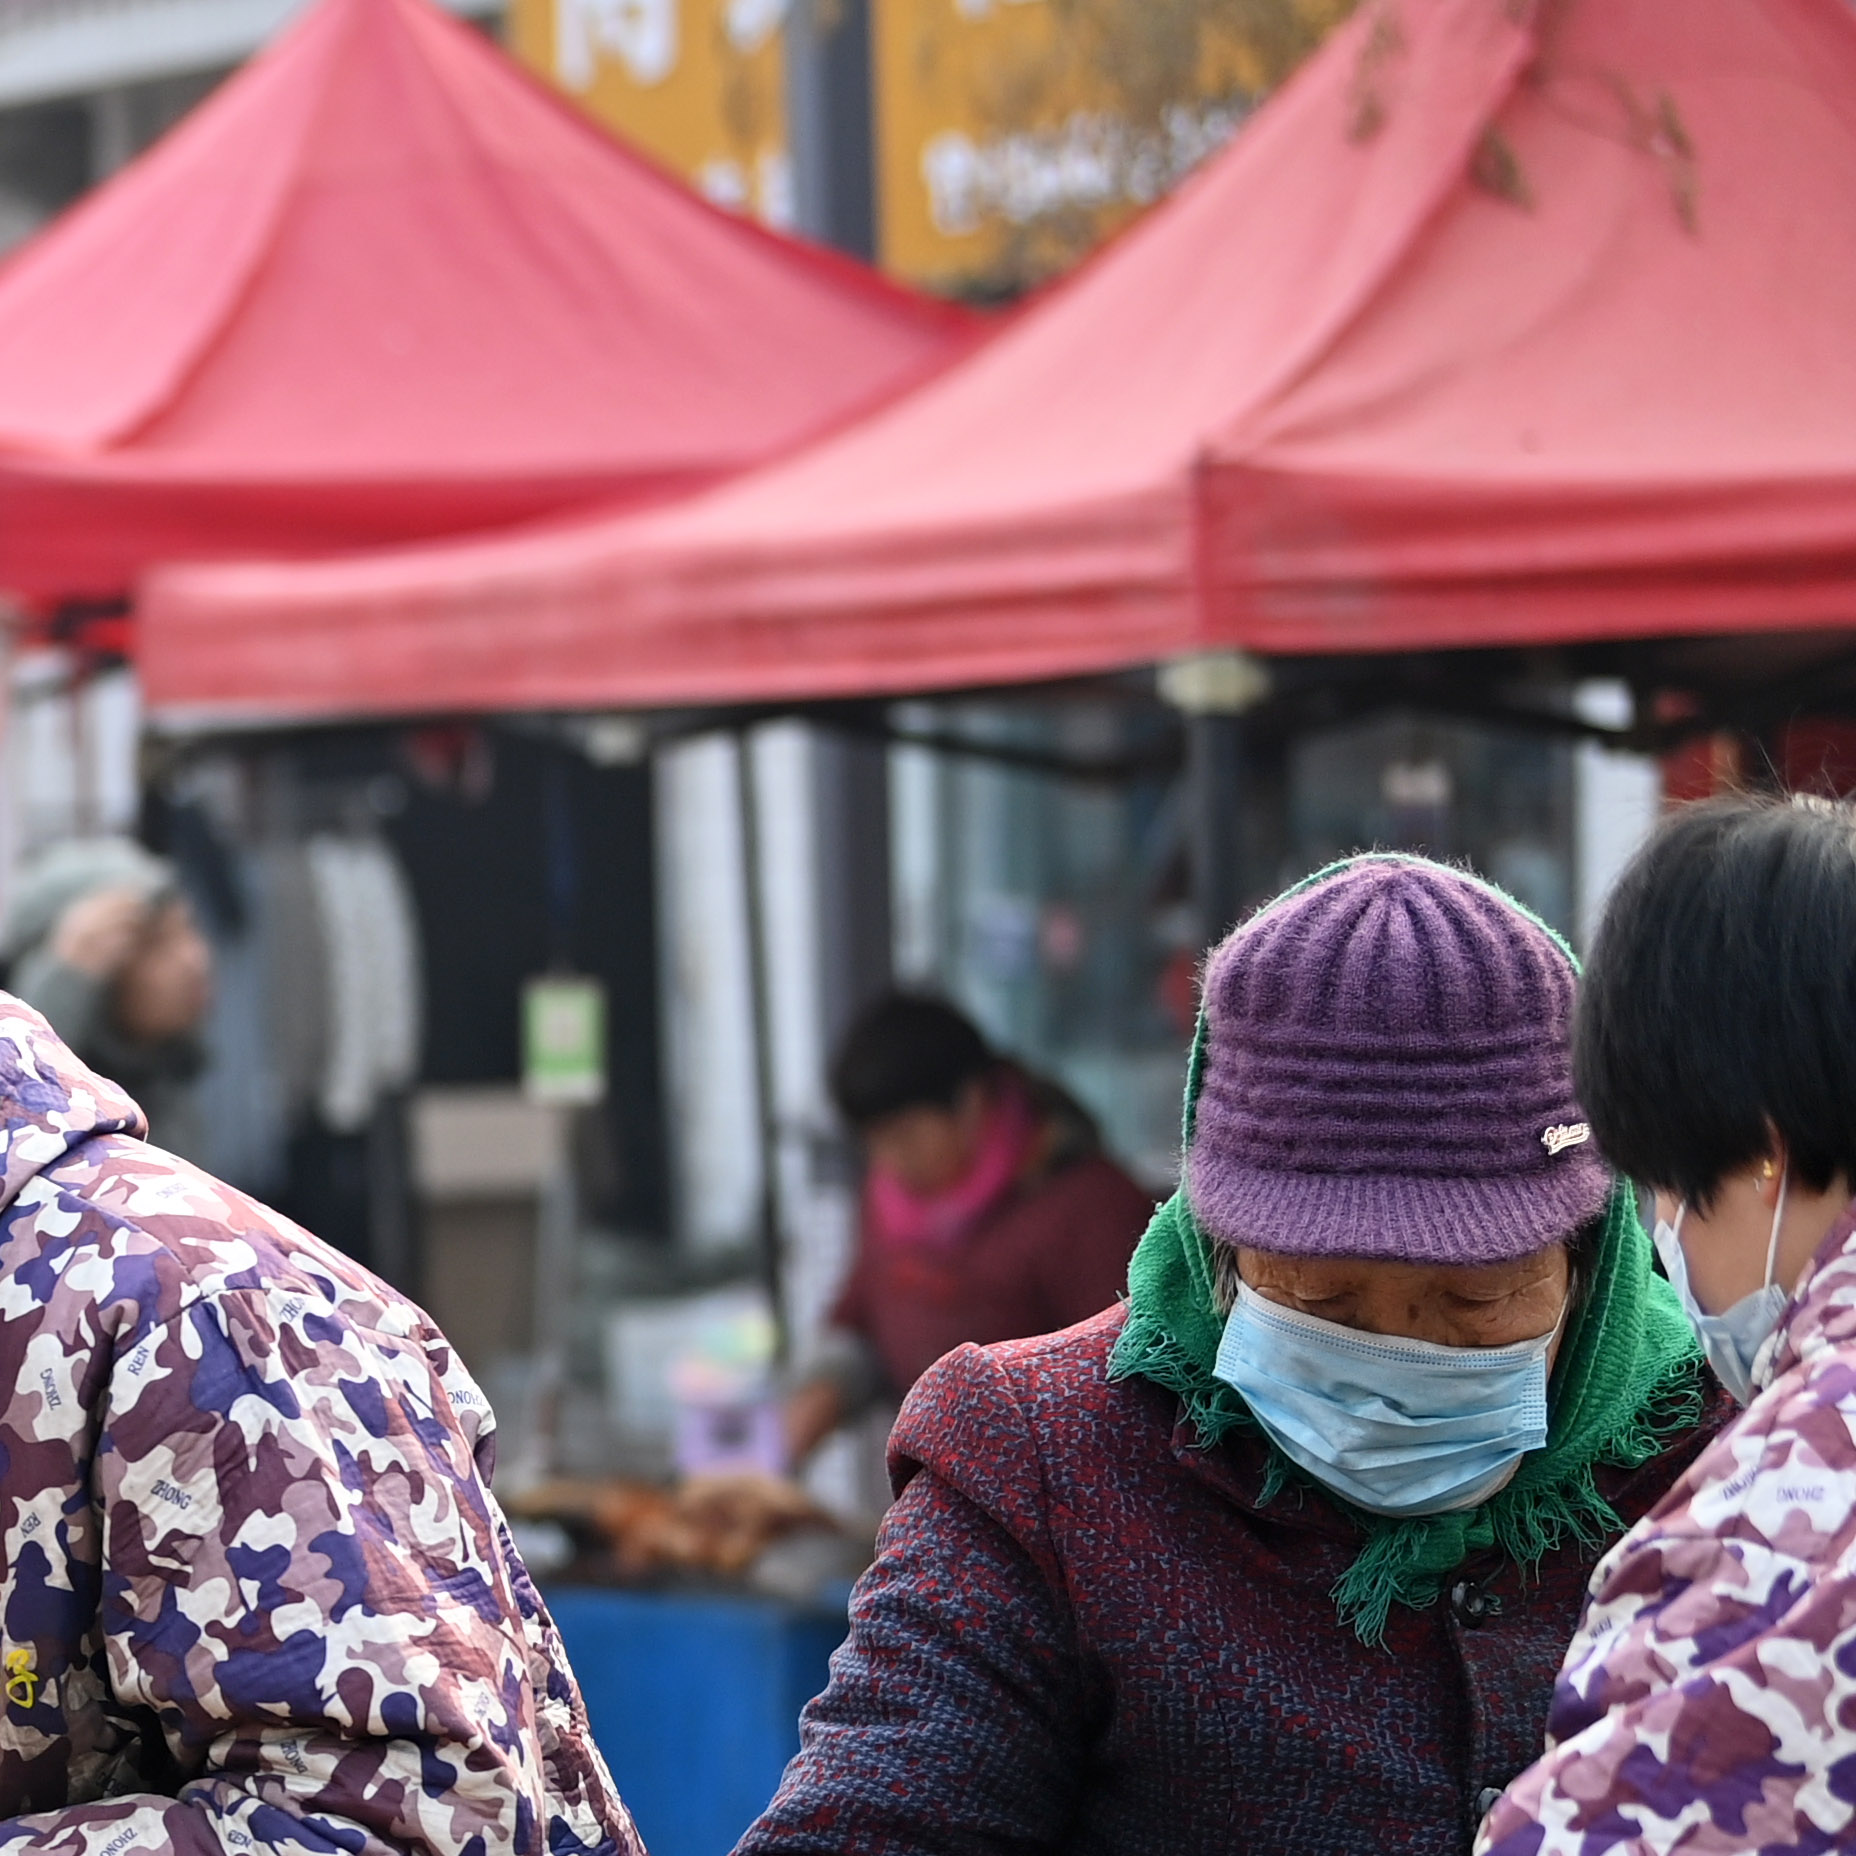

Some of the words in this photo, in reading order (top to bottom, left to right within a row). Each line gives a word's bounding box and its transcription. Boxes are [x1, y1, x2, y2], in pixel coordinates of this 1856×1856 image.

[128, 1345, 150, 1376] REN
[40, 1368, 62, 1411] ZHONG
[150, 1479, 192, 1510] ZHONG
[20, 1512, 42, 1538] REN
